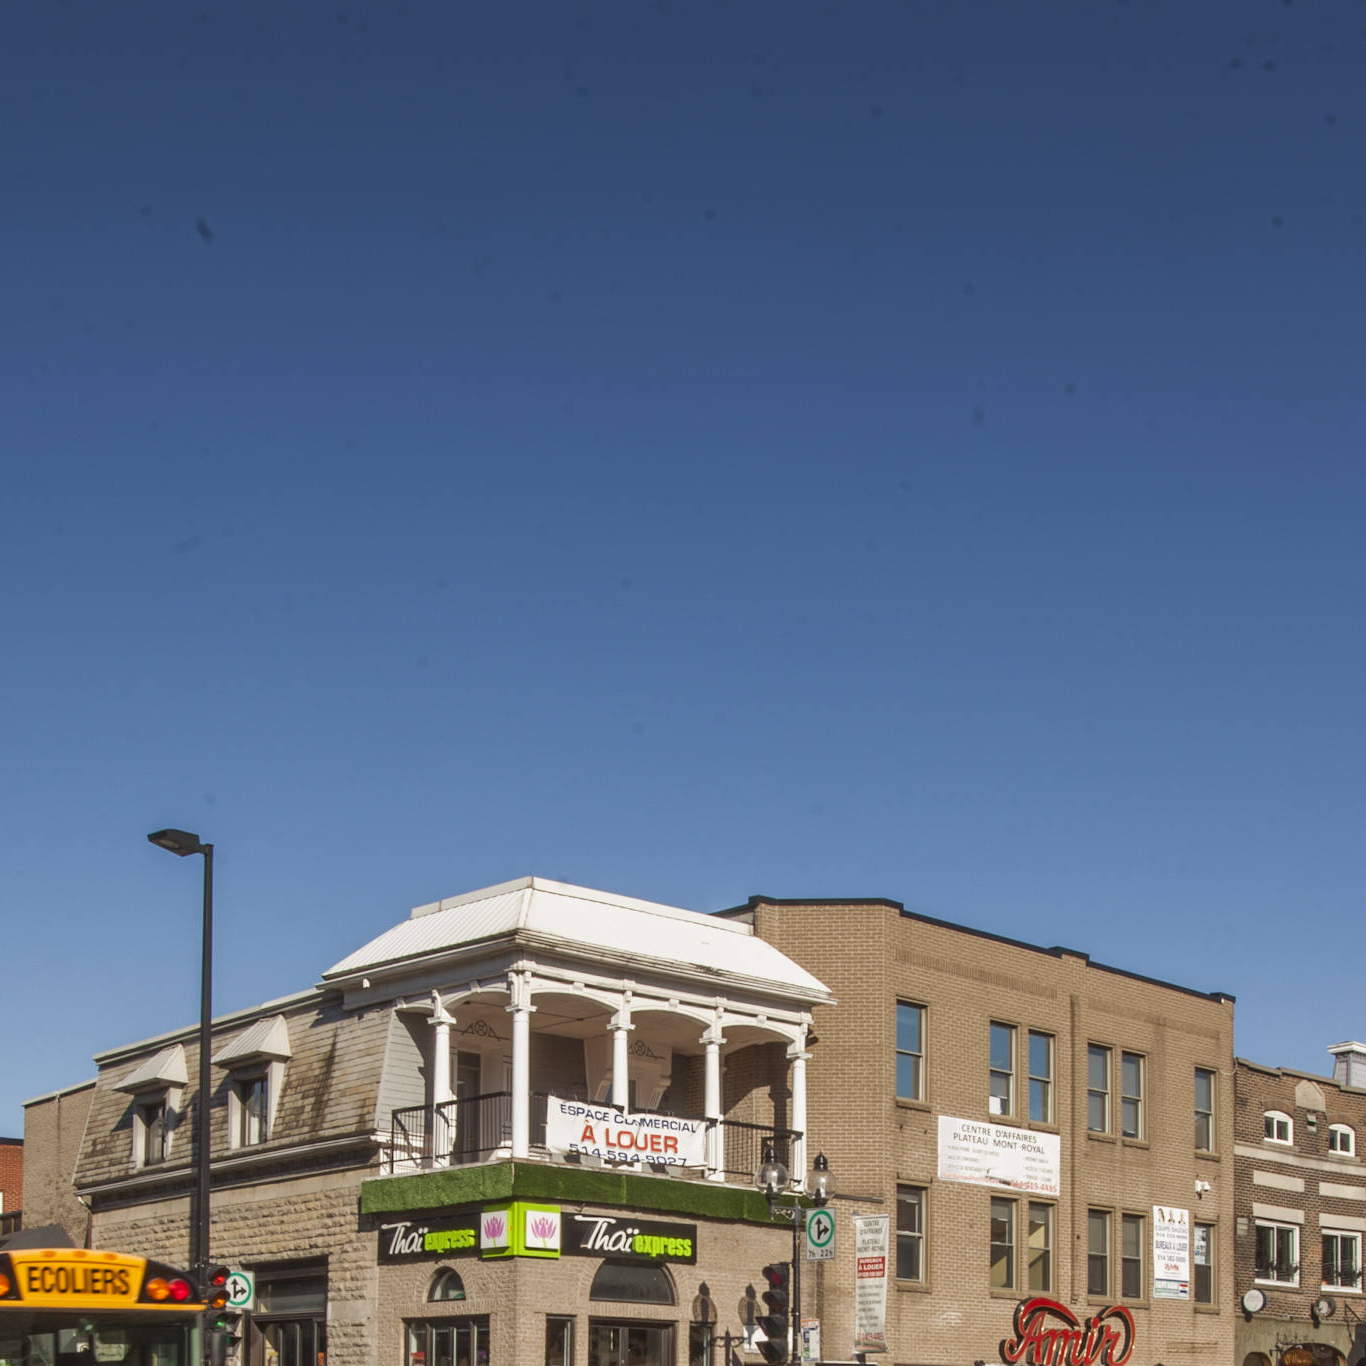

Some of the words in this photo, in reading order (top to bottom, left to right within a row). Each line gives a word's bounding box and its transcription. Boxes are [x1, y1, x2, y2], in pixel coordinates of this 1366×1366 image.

[560, 1103, 610, 1122] ESPACE
[581, 1119, 596, 1144] À
[605, 1128, 679, 1154] LOUER
[953, 1133, 989, 1145] PLATEAU
[961, 1124, 992, 1136] CENTRE
[995, 1130, 1037, 1143] D'AFFAIRES
[569, 1143, 688, 1166] 514-594-9027
[381, 1222, 429, 1254] Thaï
[424, 1229, 476, 1254] express
[574, 1215, 640, 1252] Thaï
[633, 1234, 692, 1257] express
[863, 1263, 884, 1271] LOUER
[27, 1266, 130, 1295] ECOLIERS
